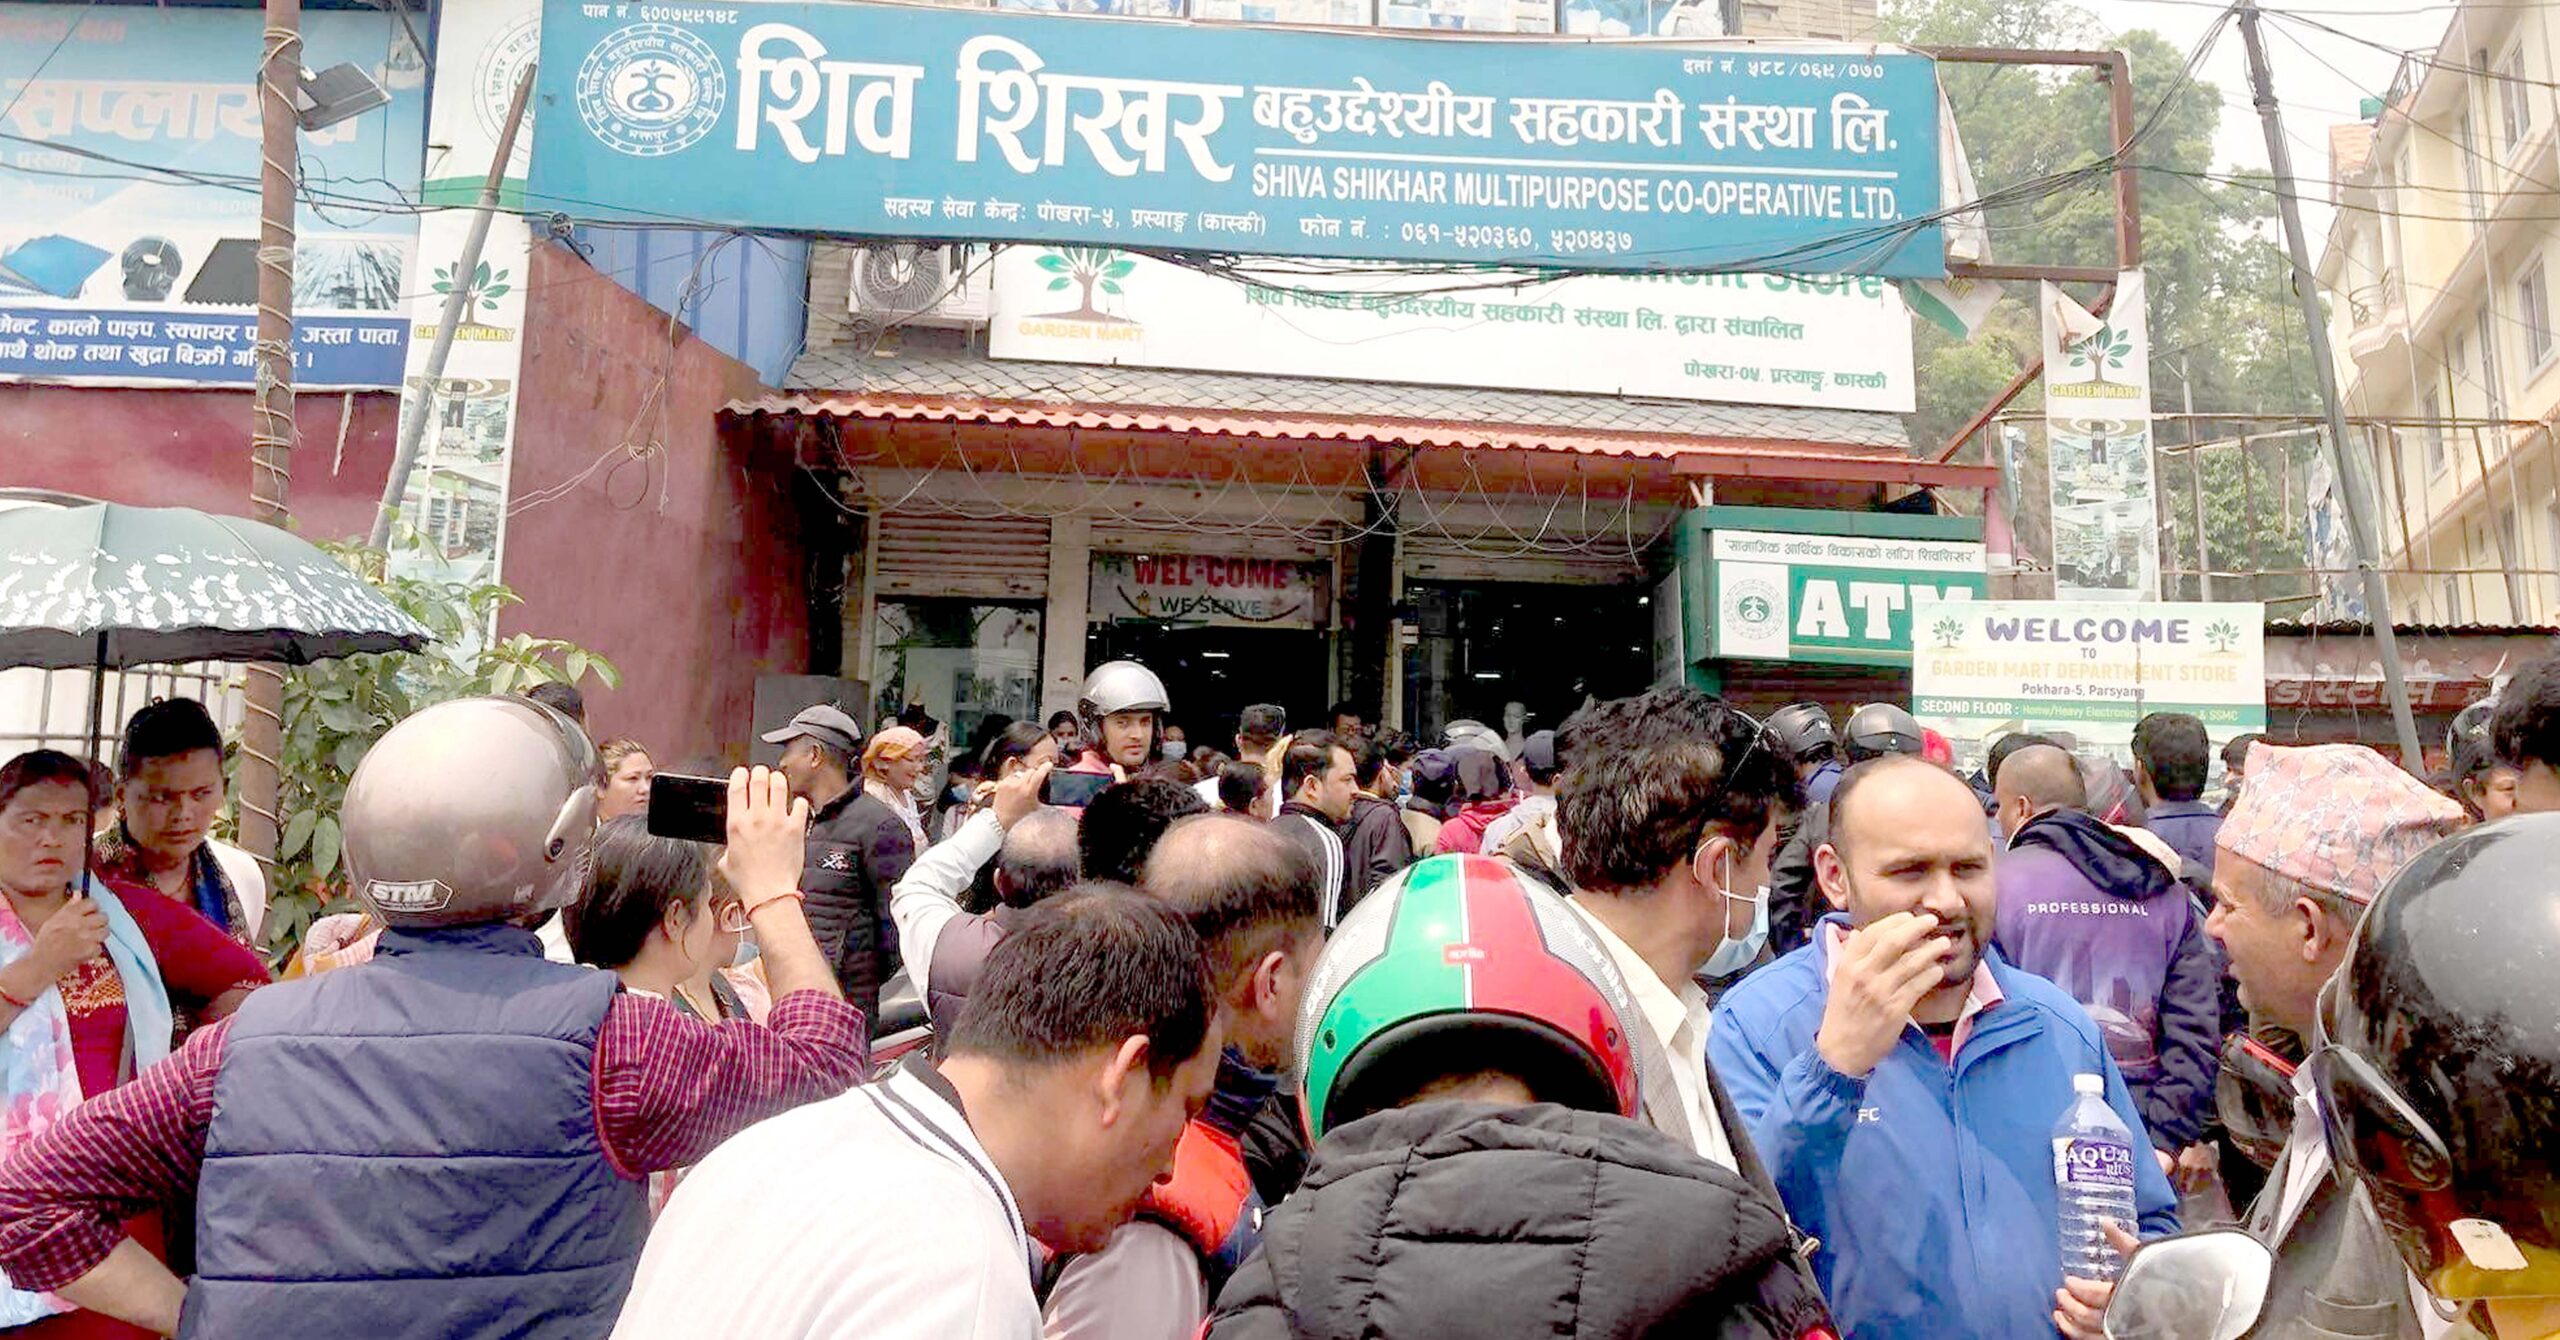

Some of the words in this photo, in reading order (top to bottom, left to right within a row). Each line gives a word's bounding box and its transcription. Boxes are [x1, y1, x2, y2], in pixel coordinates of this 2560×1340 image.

[736, 22, 923, 164] शिव
[956, 34, 1243, 184] शिखर
[1253, 77, 1496, 144] बहुउद्देश्यीय
[1510, 88, 1683, 150] सहकारी
[1699, 96, 1815, 152] संस्था
[1831, 91, 1898, 153] लि.
[1253, 163, 1327, 200] SHIVA
[1333, 167, 1447, 205] SHIKHAR
[1454, 173, 1650, 213] MULTIPURPOSE
[1657, 180, 1843, 221] CO-OPERATIVE
[1850, 186, 1902, 222] LTD.
[884, 197, 935, 218] सदस्य
[942, 196, 974, 217] सेवा
[1197, 208, 1267, 235] (कास्की)
[1299, 213, 1341, 239] फोन
[1551, 227, 1633, 253] ५२०४३७
[1482, 299, 1565, 325] सहकारी
[1574, 306, 1628, 329] संस्था
[48, 315, 101, 337] कालो
[301, 326, 354, 345] जस्ता
[414, 324, 471, 342] GAEN
[1018, 321, 1093, 341] GARDEN
[1096, 327, 1145, 343] MART
[33, 339, 79, 361] थोक
[83, 343, 124, 362] तथा
[1834, 371, 1887, 389] कास्की
[2049, 383, 2102, 398] GARDEN
[2104, 384, 2141, 399] MART
[1159, 596, 1192, 613] WE
[1985, 616, 2190, 644] WELCOME
[2080, 647, 2097, 660] TO
[1931, 660, 1998, 679] GARDEN
[2003, 661, 2053, 679] MART
[2056, 662, 2174, 682] DEPARTMENT
[2180, 664, 2237, 683] STORE
[2021, 683, 2086, 698] Pokhara-5,
[2088, 684, 2145, 700] Parsyang
[1921, 699, 1970, 714] SECOND
[373, 884, 435, 902] STM
[2027, 902, 2149, 917] PROFESSIONAL
[2067, 1146, 2132, 1170] AQUA
